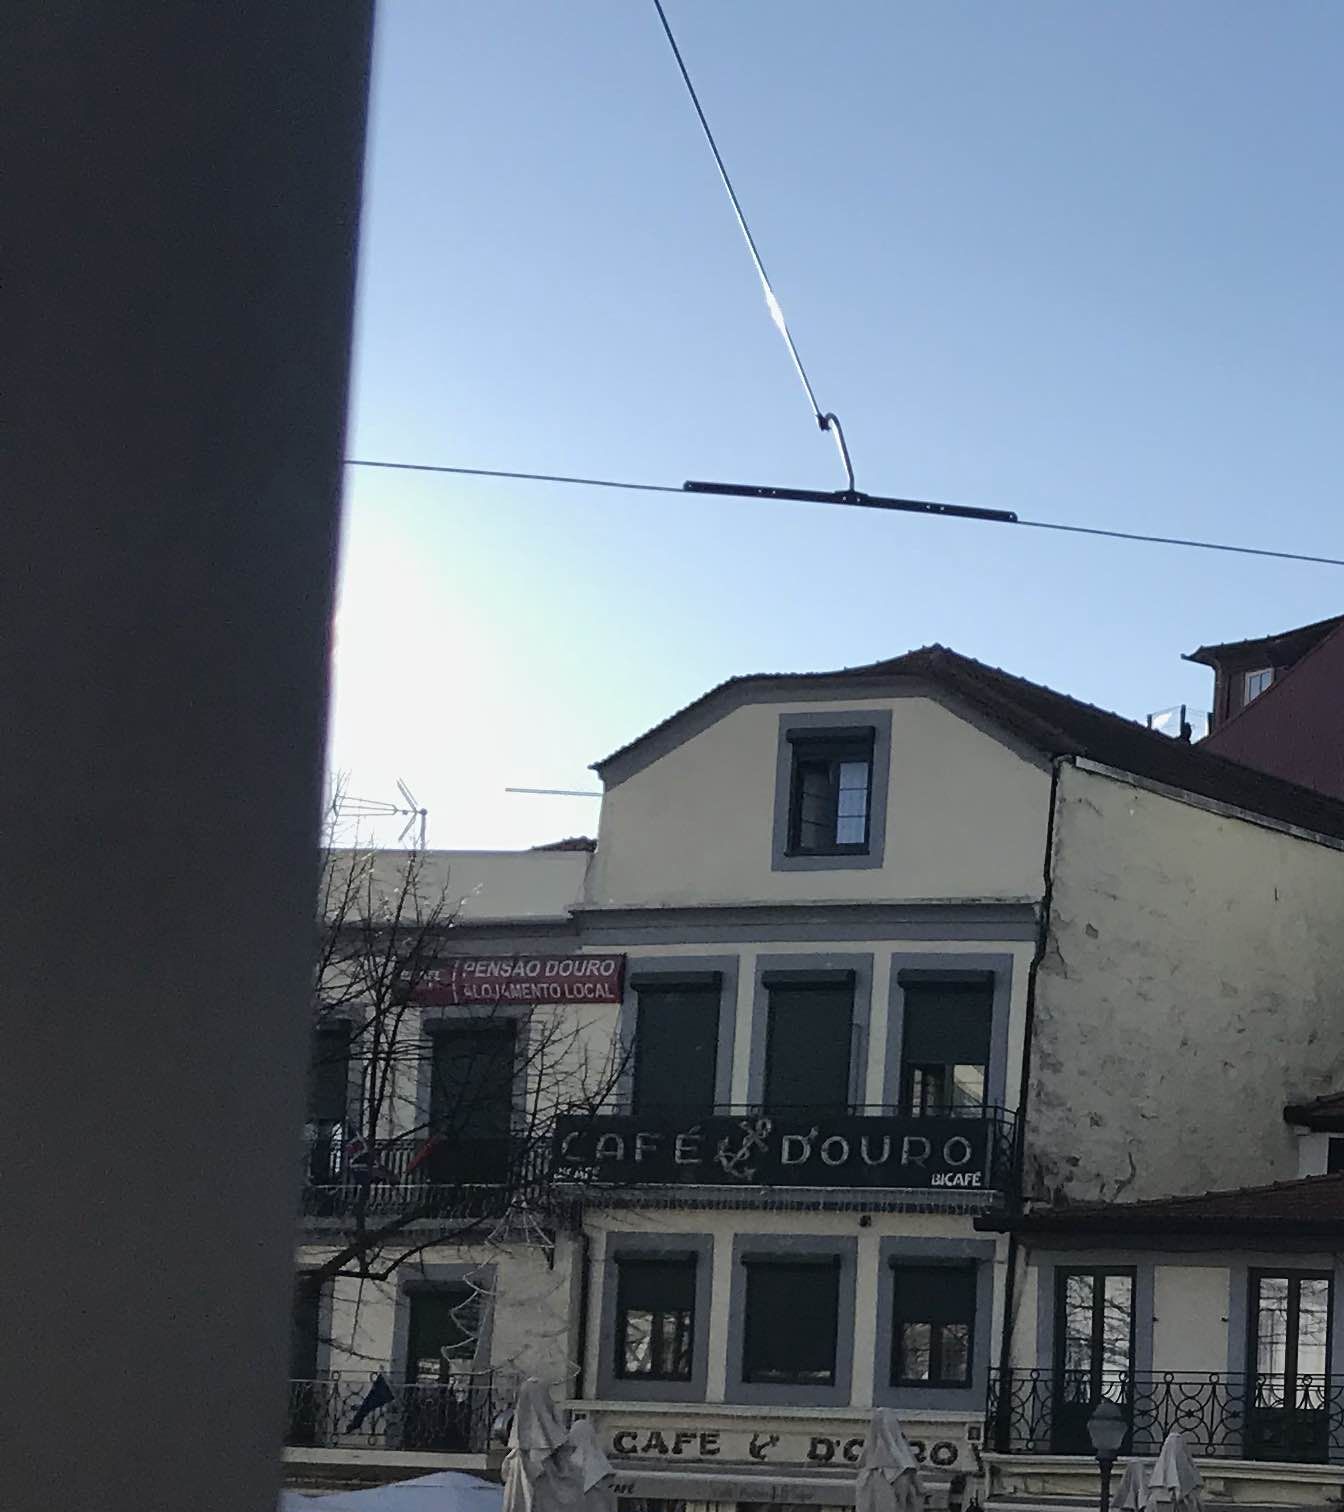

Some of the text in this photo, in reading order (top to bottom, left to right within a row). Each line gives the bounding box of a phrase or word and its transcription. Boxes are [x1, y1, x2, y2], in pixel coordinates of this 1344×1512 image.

[544, 959, 617, 977] DOURO
[463, 983, 615, 1000] ALOJAMENTO LOCAL
[561, 1125, 972, 1167] CAFÉ D'OURO
[930, 1171, 983, 1187] BICAFÉ
[806, 1436, 959, 1466] D'ORO
